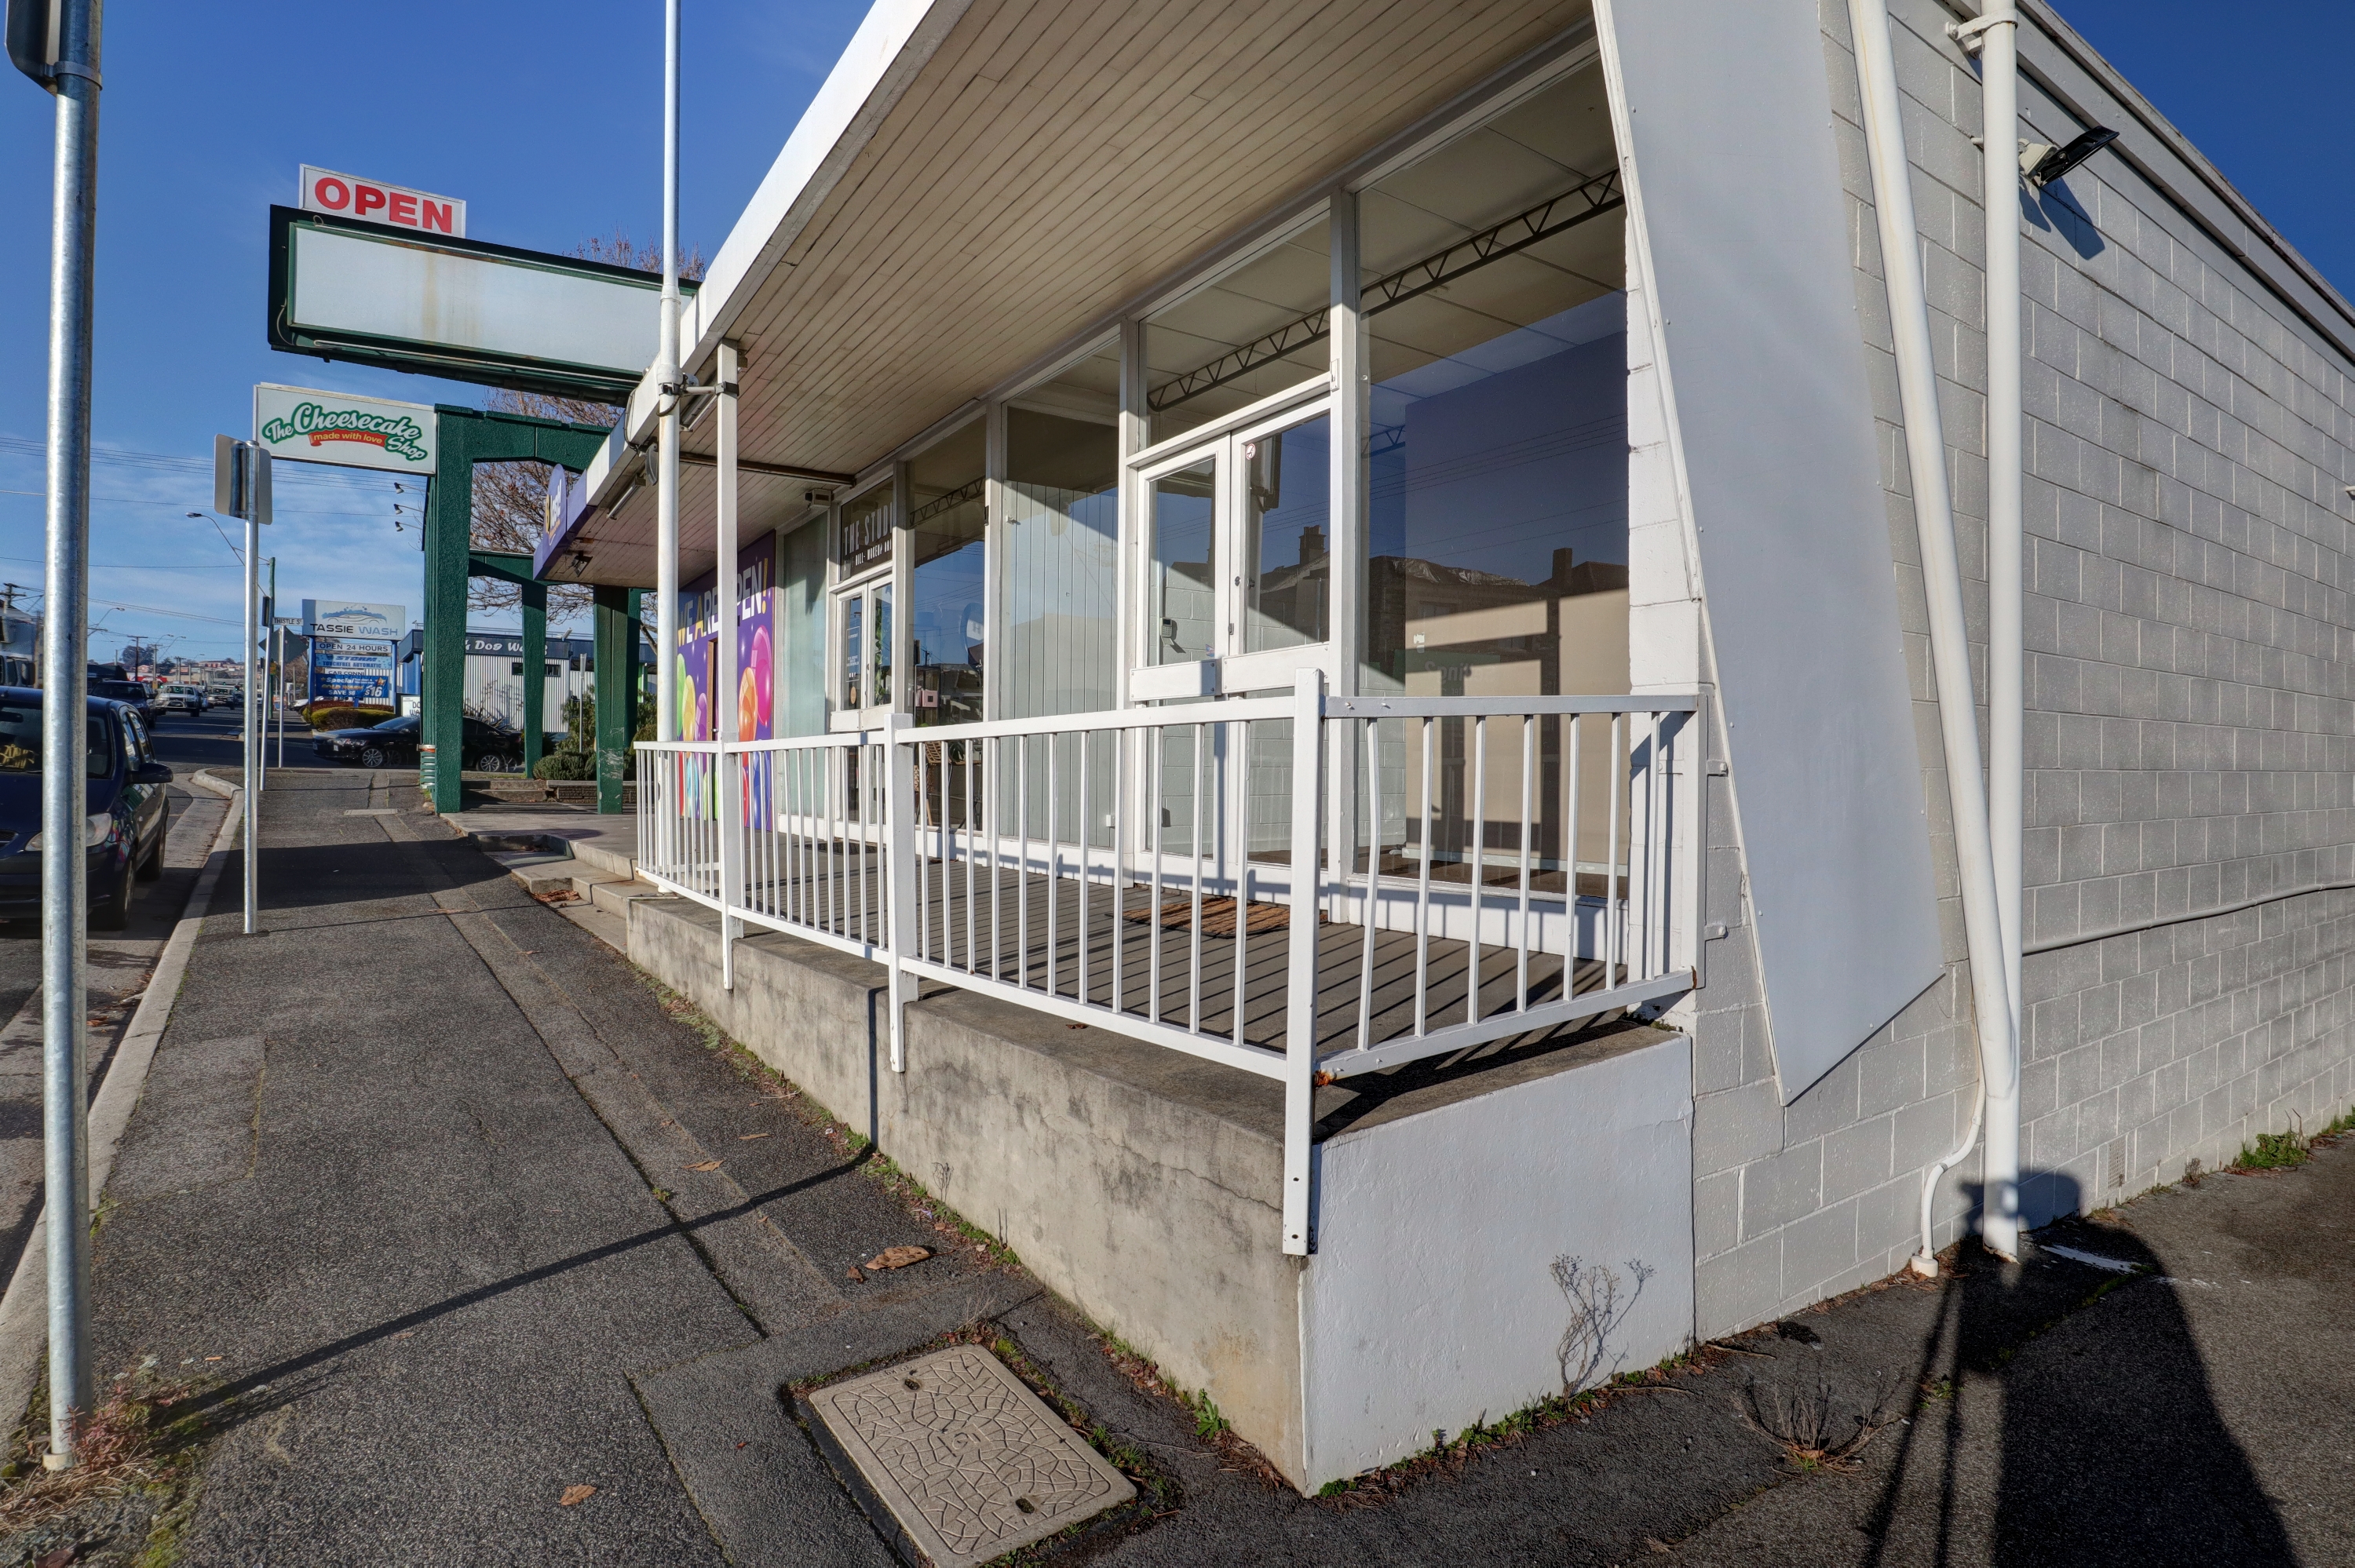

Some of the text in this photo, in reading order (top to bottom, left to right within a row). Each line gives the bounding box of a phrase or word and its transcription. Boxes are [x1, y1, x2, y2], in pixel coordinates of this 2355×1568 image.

[315, 177, 452, 234] OPEN
[264, 403, 427, 460] The Cheesecake Shop
[314, 432, 383, 444] made with love
[844, 520, 859, 556] THE
[677, 600, 693, 647] WE
[695, 585, 719, 640] ARE
[310, 623, 398, 636] TASSIE WASH
[475, 640, 503, 651] Dog
[364, 686, 383, 697] $16
